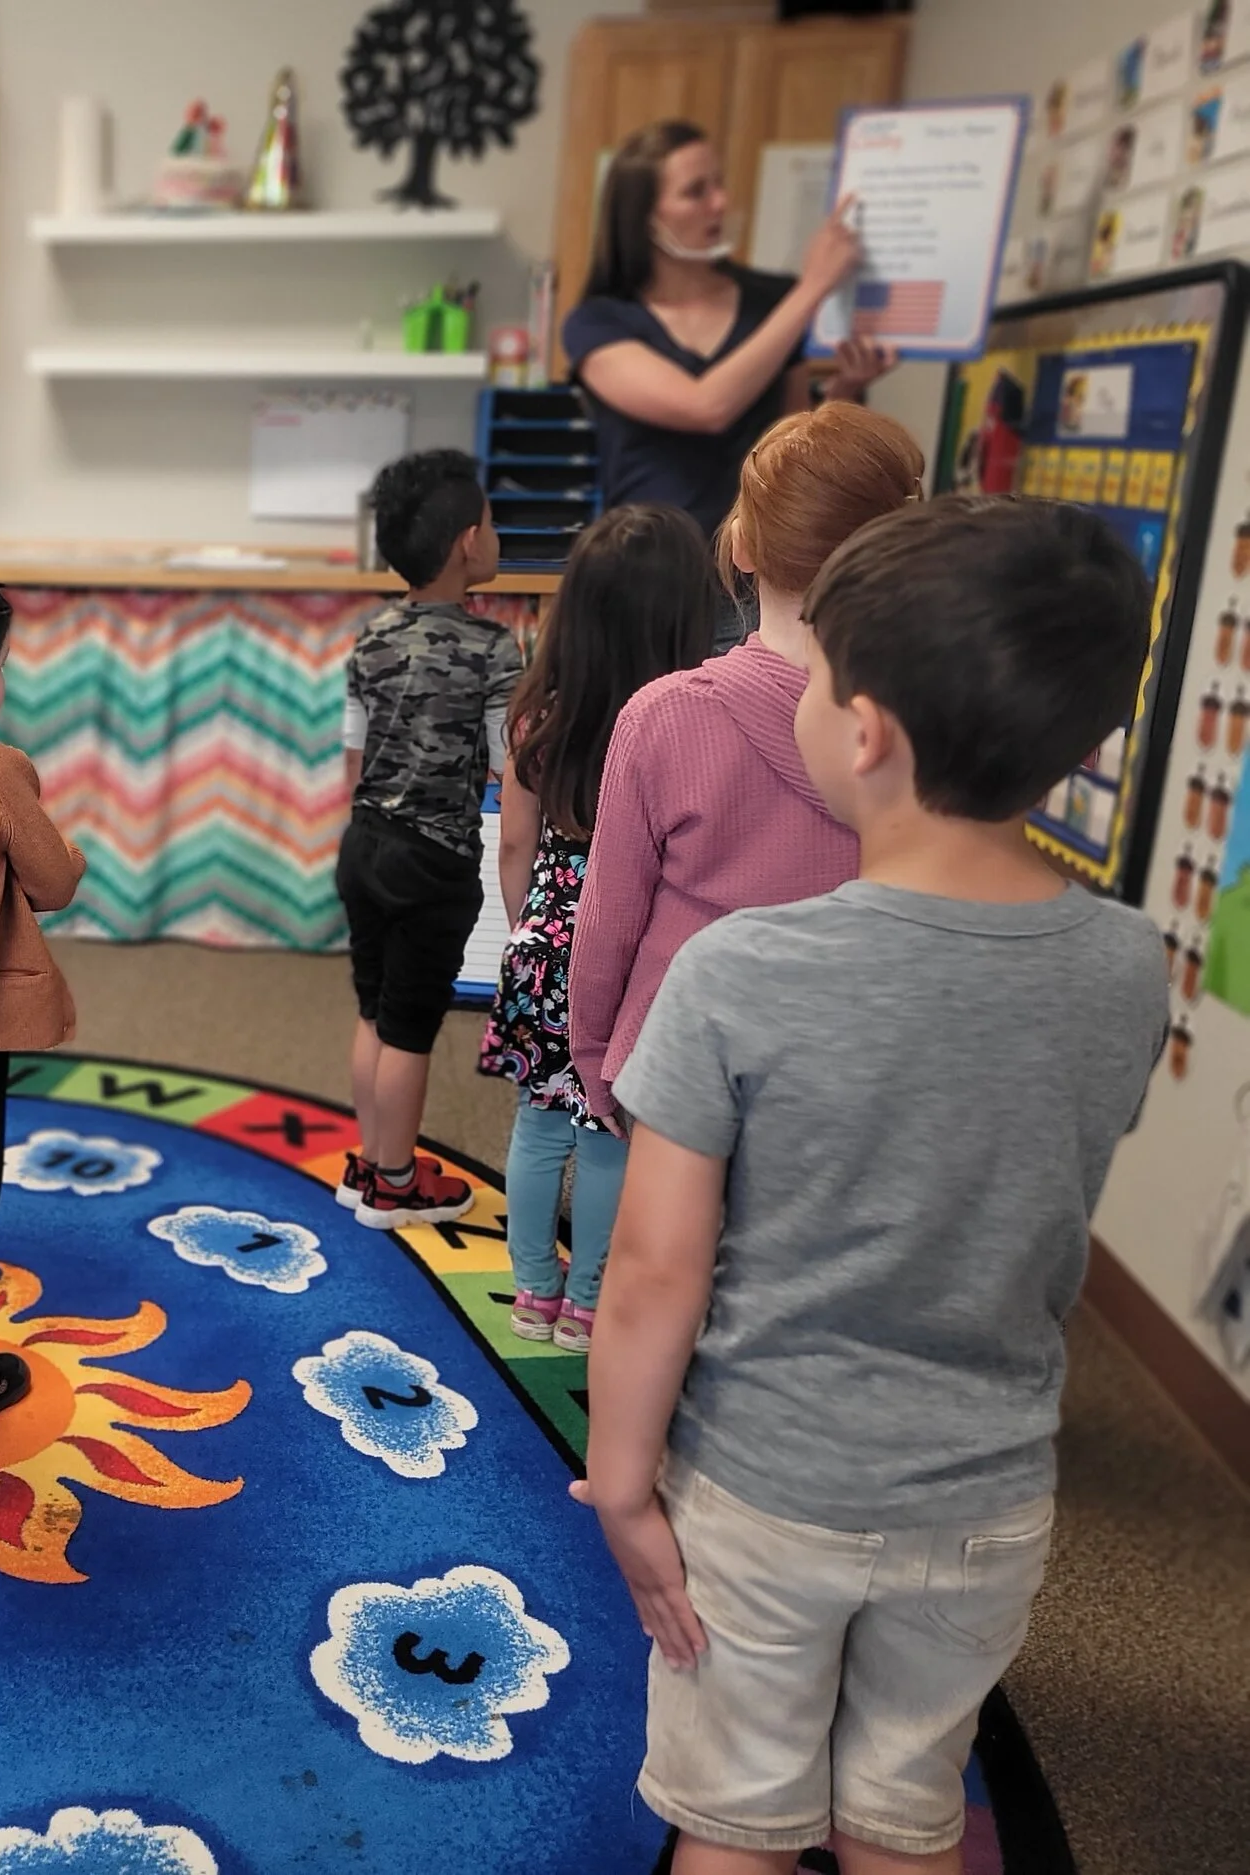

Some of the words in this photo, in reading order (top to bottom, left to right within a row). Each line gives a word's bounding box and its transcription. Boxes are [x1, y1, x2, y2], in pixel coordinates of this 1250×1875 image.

[100, 1073, 206, 1107] W
[242, 1111, 341, 1150] X
[42, 1151, 115, 1179] 10
[362, 1384, 433, 1410] 2
[392, 1631, 485, 1685] 3
